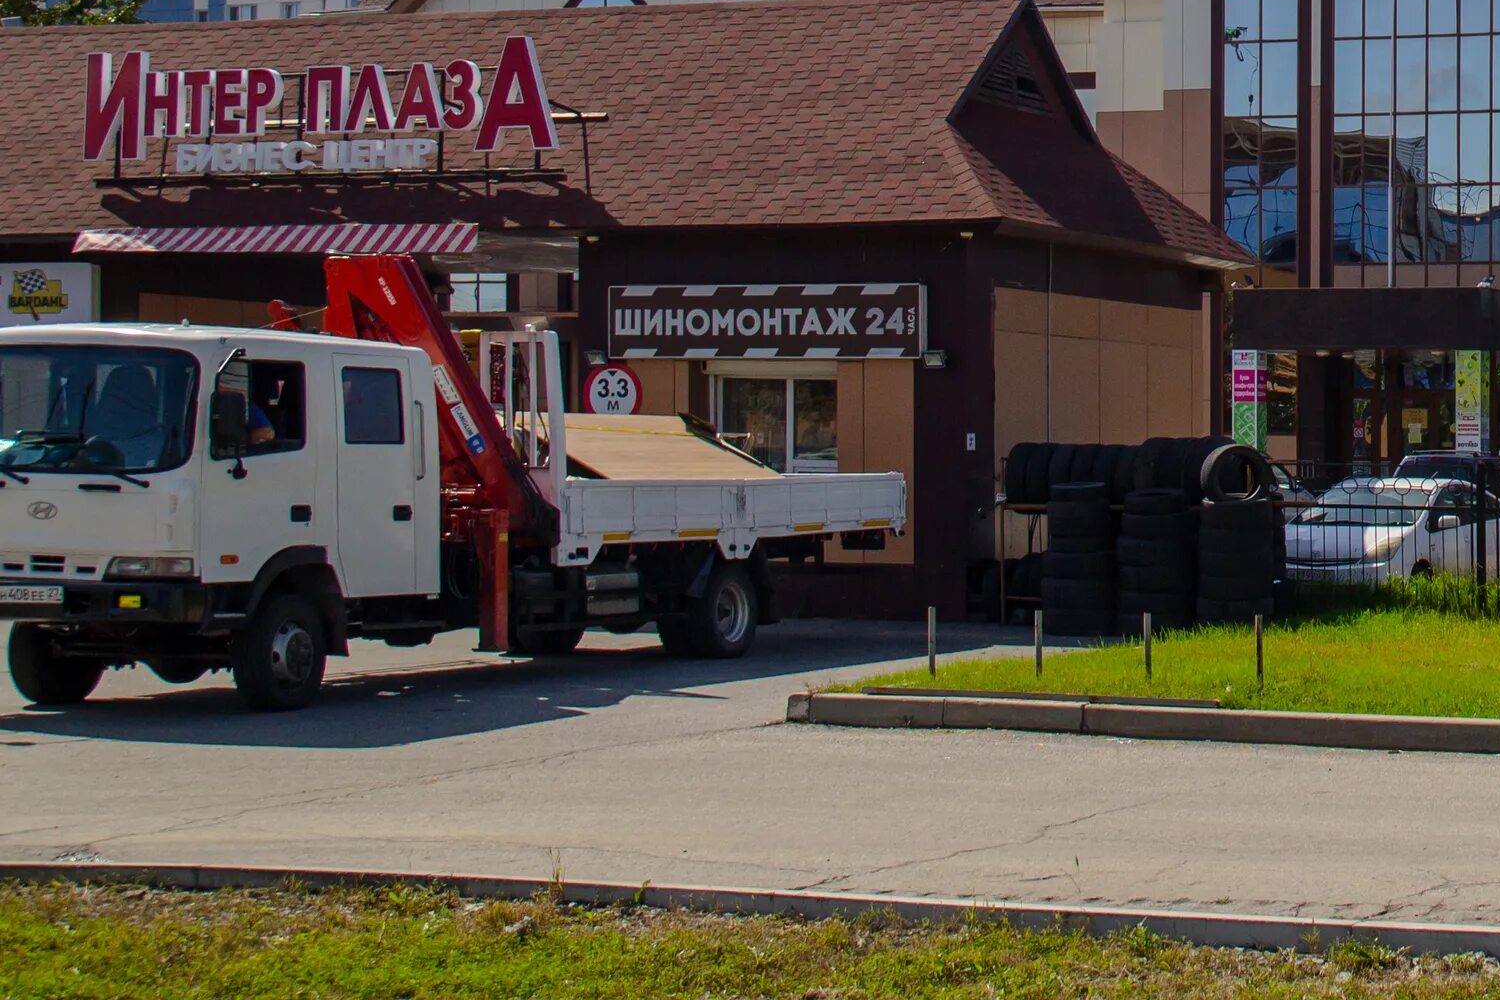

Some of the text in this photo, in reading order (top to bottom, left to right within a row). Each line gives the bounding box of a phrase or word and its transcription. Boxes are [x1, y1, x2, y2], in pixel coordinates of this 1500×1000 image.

[176, 138, 439, 173] БИЗНЕС ЦЕНТР
[614, 307, 906, 336] ШИНОМОНТАЖ 24
[906, 306, 916, 335] ЧАСА
[597, 378, 629, 398] 3.3
